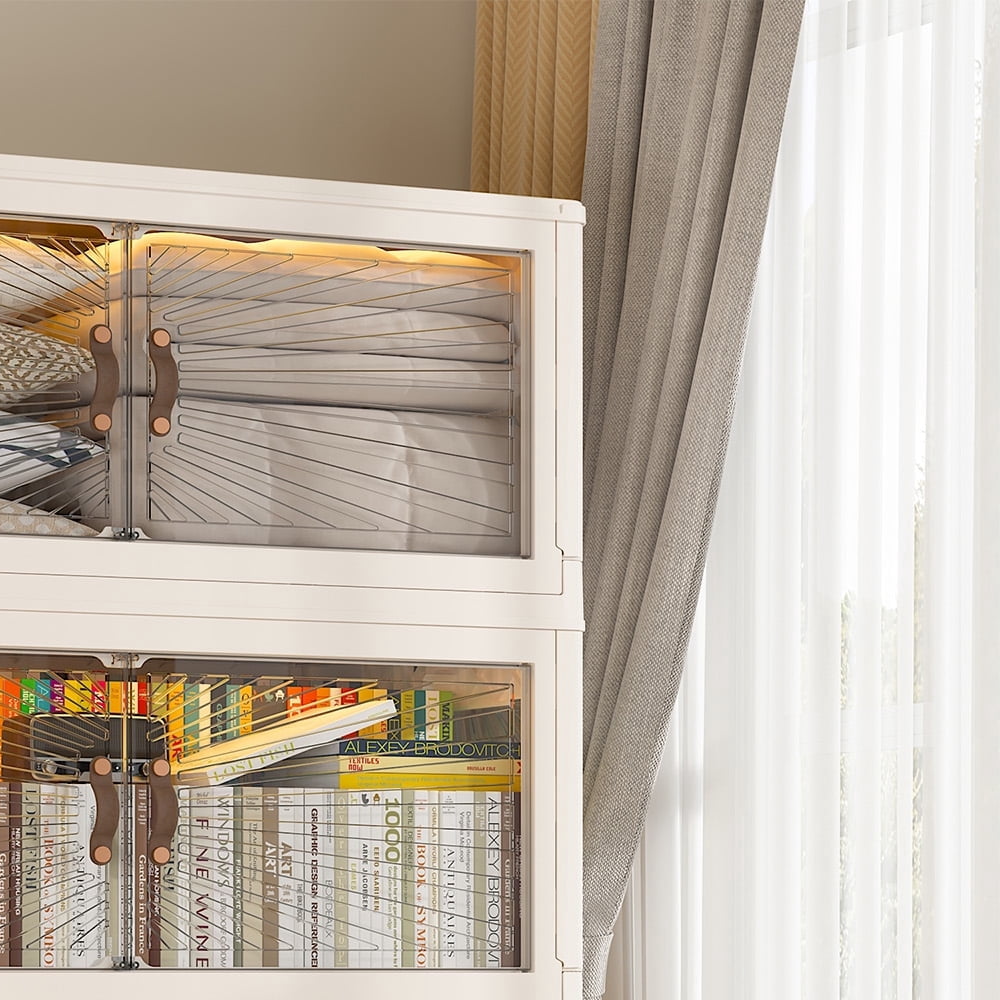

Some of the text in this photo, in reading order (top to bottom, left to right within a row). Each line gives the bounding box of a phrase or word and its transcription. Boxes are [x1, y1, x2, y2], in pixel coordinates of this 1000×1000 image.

[344, 743, 520, 757] ALEXEY BRODOVITCH
[441, 703, 450, 743] MAKIN
[347, 756, 380, 765] TEXTILES
[26, 789, 37, 890] LOST FISH
[217, 794, 230, 888] WINDOWS
[264, 841, 277, 875] ART
[281, 841, 293, 877] ART
[385, 797, 401, 864] 1000
[488, 797, 500, 871] ALEXEY
[43, 840, 54, 886] BOOK
[196, 818, 209, 967] FINE WINE
[311, 808, 319, 967] GRAPHIC DESIGN REFERENCE
[416, 844, 427, 888] BOOK
[77, 844, 85, 957] ANTIQUARES
[137, 854, 147, 955] Gardens in France
[447, 848, 455, 958] ANTIQUAIRES
[43, 903, 54, 967] SYMBO
[219, 935, 227, 967] GOODMA
[416, 906, 427, 967] SYMBO
